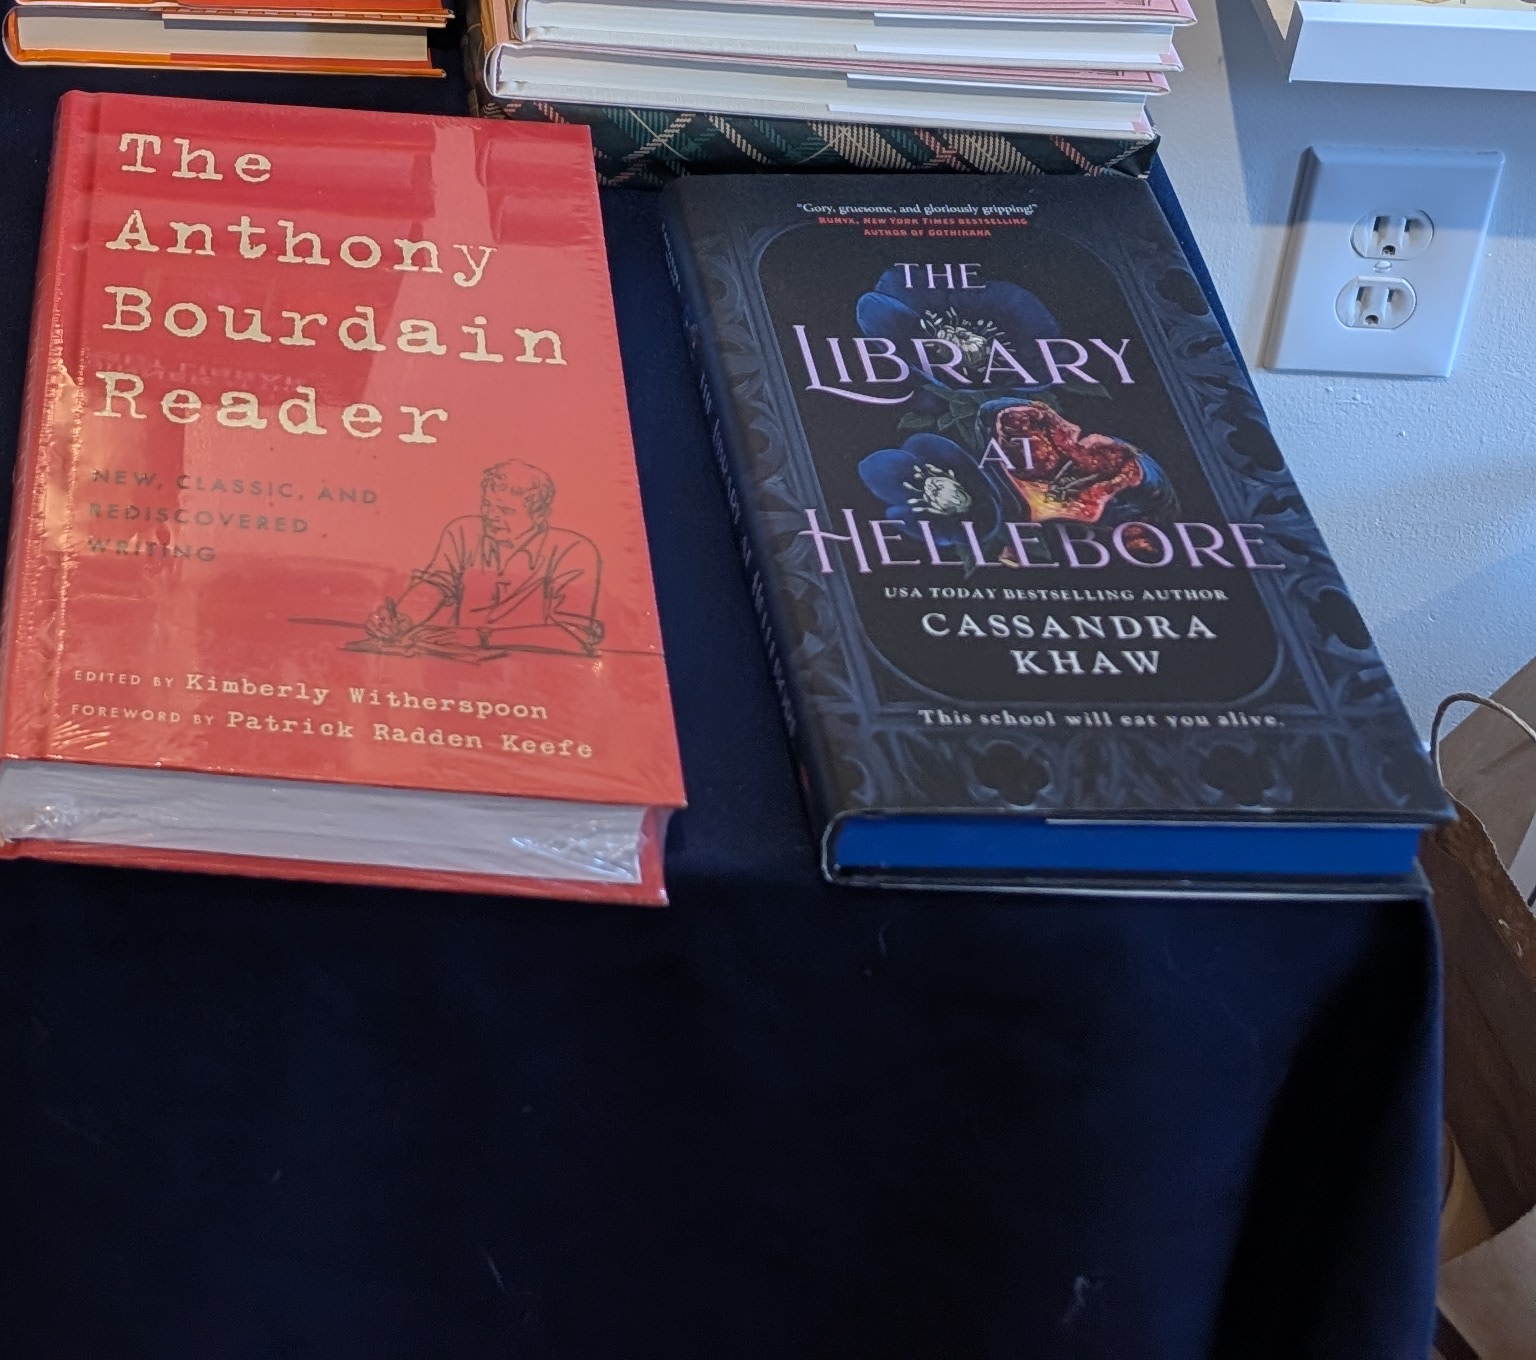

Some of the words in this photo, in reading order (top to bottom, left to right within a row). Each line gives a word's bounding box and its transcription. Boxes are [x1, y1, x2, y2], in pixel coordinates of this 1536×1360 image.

[118, 133, 273, 183] The
[105, 211, 497, 288] Anthony
[894, 262, 986, 290] THE
[102, 286, 568, 365] Bourdain
[792, 324, 1136, 406] LIBRARY
[92, 371, 450, 444] Reader
[978, 437, 1039, 471] AT
[798, 508, 1286, 574] HELLEBORE
[884, 586, 922, 599] USA
[928, 586, 997, 601] TODAY
[1002, 587, 1134, 602] BESTSELLING
[1142, 587, 1228, 602] AUTHOR
[922, 612, 1217, 640] CASSANDRA
[1010, 649, 1163, 676] KHAW
[75, 670, 141, 687] EDITED
[154, 677, 175, 688] BY
[185, 676, 329, 705] Kimberly
[350, 687, 549, 721] Witherspoon
[71, 703, 181, 723] FOREWORD
[194, 714, 215, 725] BY
[226, 712, 354, 739] Patrick
[374, 724, 484, 748] Radden
[501, 735, 592, 758] Keefe
